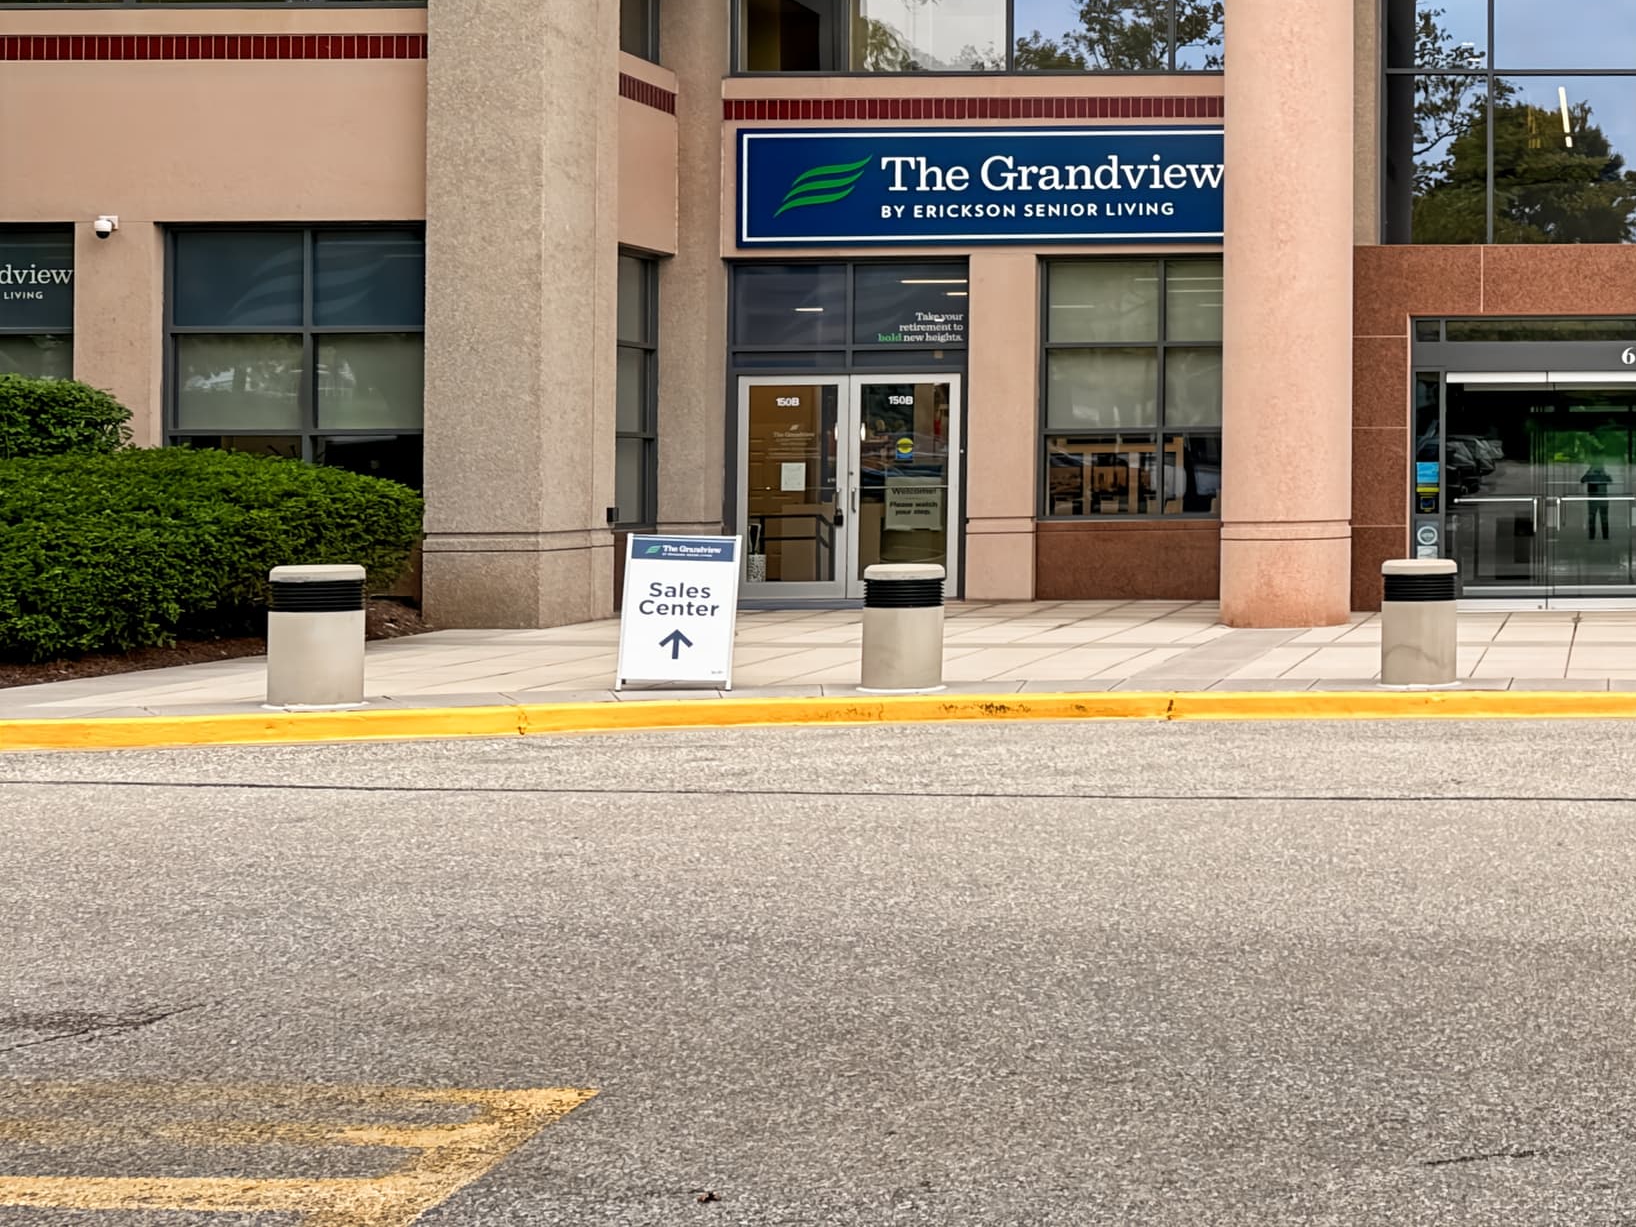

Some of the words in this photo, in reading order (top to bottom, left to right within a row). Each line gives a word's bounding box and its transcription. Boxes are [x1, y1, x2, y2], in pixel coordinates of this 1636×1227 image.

[881, 156, 970, 192] The
[980, 154, 1225, 192] Grandview
[881, 204, 906, 219] BY
[913, 203, 1016, 219] ERICKSON
[1023, 202, 1099, 218] SENIOR
[1105, 202, 1175, 217] LIVING
[3, 291, 44, 300] LIVING
[915, 312, 938, 321] Take
[939, 314, 964, 322] your
[899, 322, 952, 331] retirement
[953, 323, 964, 331] to
[878, 333, 902, 342] bold
[903, 334, 925, 342] new
[925, 333, 964, 343] heights.
[775, 397, 800, 407] 150B
[888, 395, 914, 405] 150B
[649, 581, 711, 599] Sales
[639, 600, 720, 617] Center
